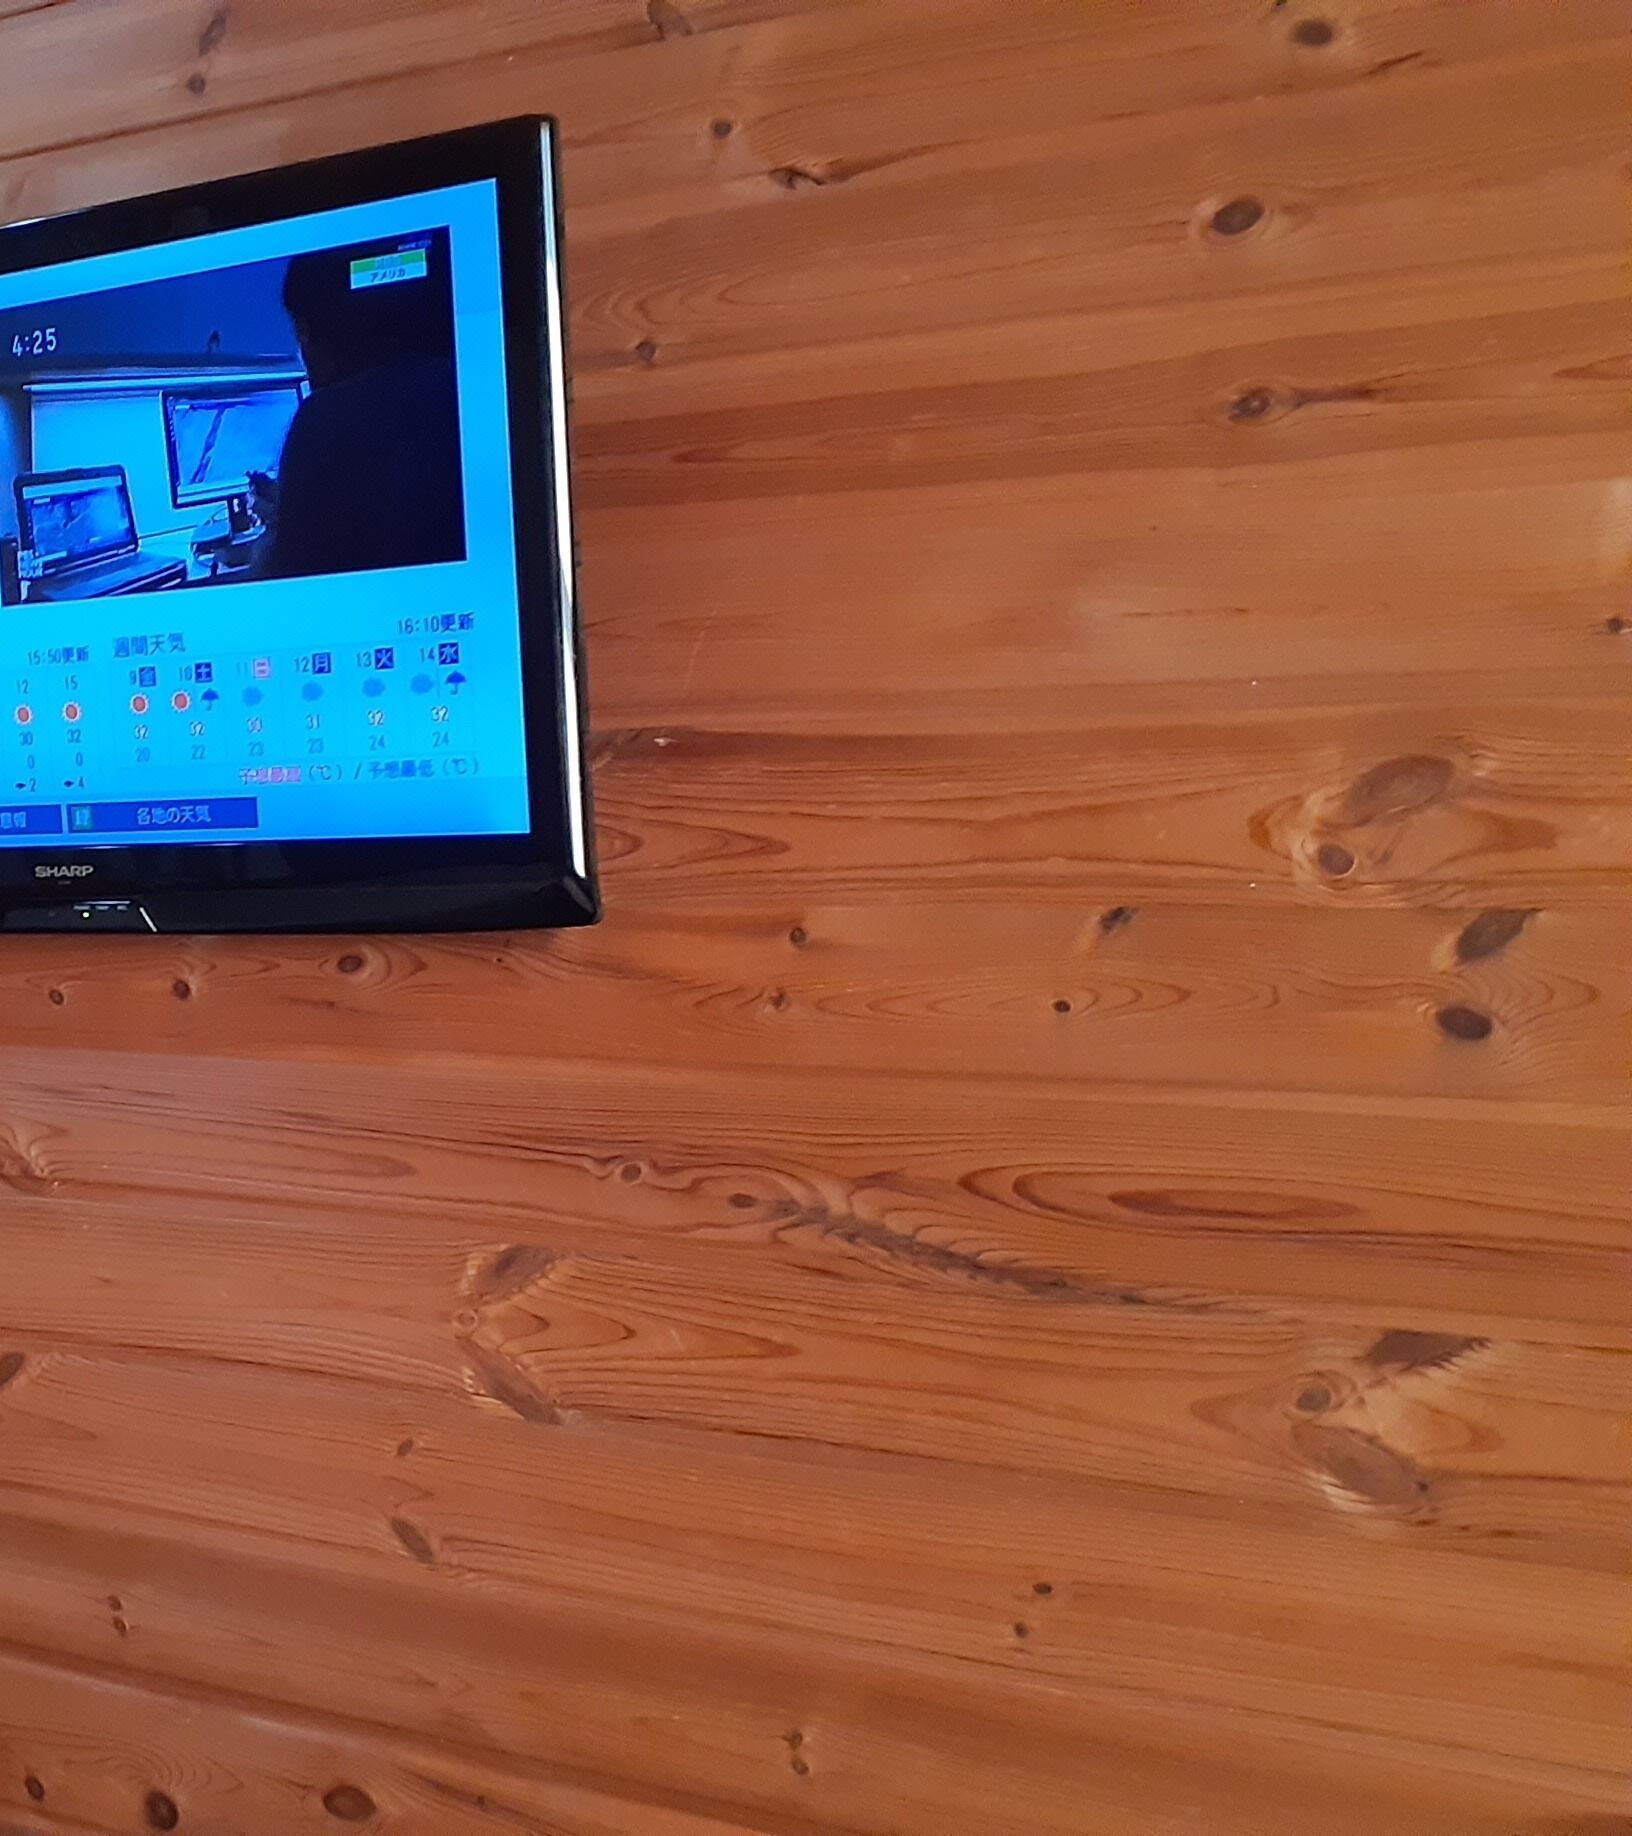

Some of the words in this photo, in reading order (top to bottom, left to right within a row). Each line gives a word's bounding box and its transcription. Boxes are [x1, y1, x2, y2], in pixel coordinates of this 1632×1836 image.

[11, 327, 58, 358] 4:25
[397, 611, 475, 635] 16:10更新
[27, 645, 90, 667] 15:50更新
[113, 632, 186, 658] 週間天気
[136, 804, 212, 826] 各地の天気
[34, 864, 95, 879] SHARP
